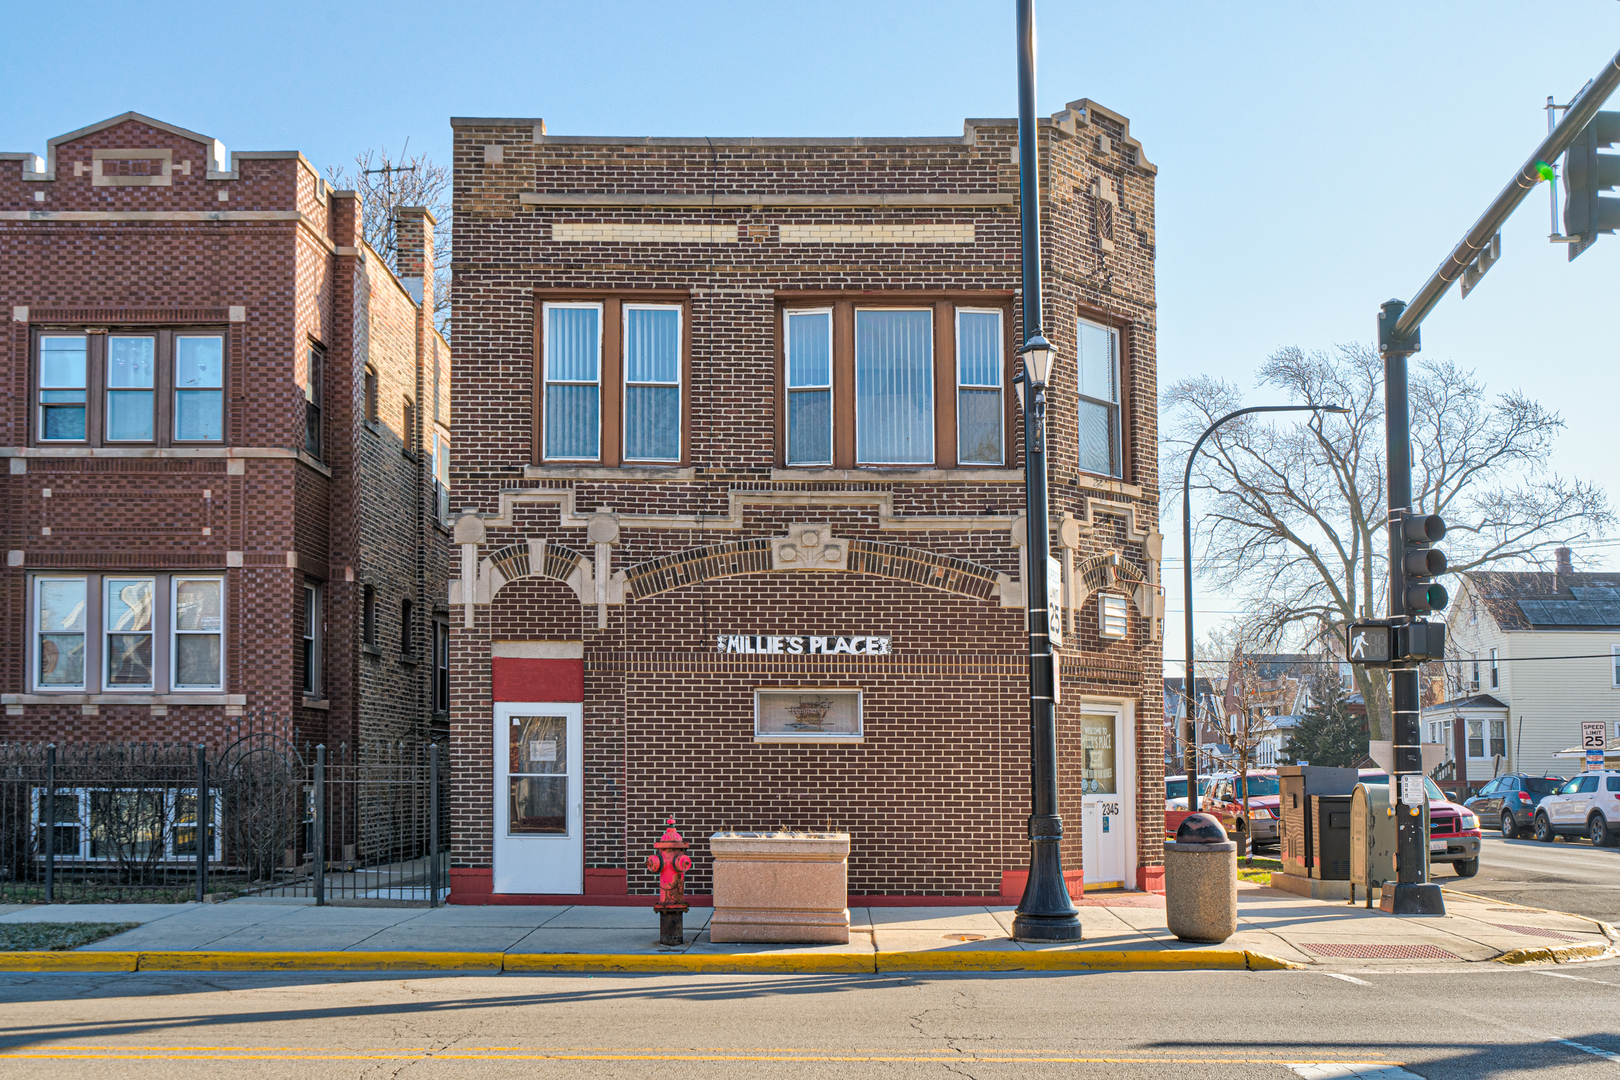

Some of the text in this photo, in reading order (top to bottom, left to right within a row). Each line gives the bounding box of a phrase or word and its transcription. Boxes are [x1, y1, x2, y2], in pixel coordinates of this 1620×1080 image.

[1049, 602, 1060, 634] 25
[727, 635, 879, 655] MILLIE'S PLACE
[1084, 726, 1108, 735] WELCOME TO
[1098, 733, 1112, 749] PLACE
[1585, 735, 1604, 746] 25
[1102, 802, 1119, 816] 2345
